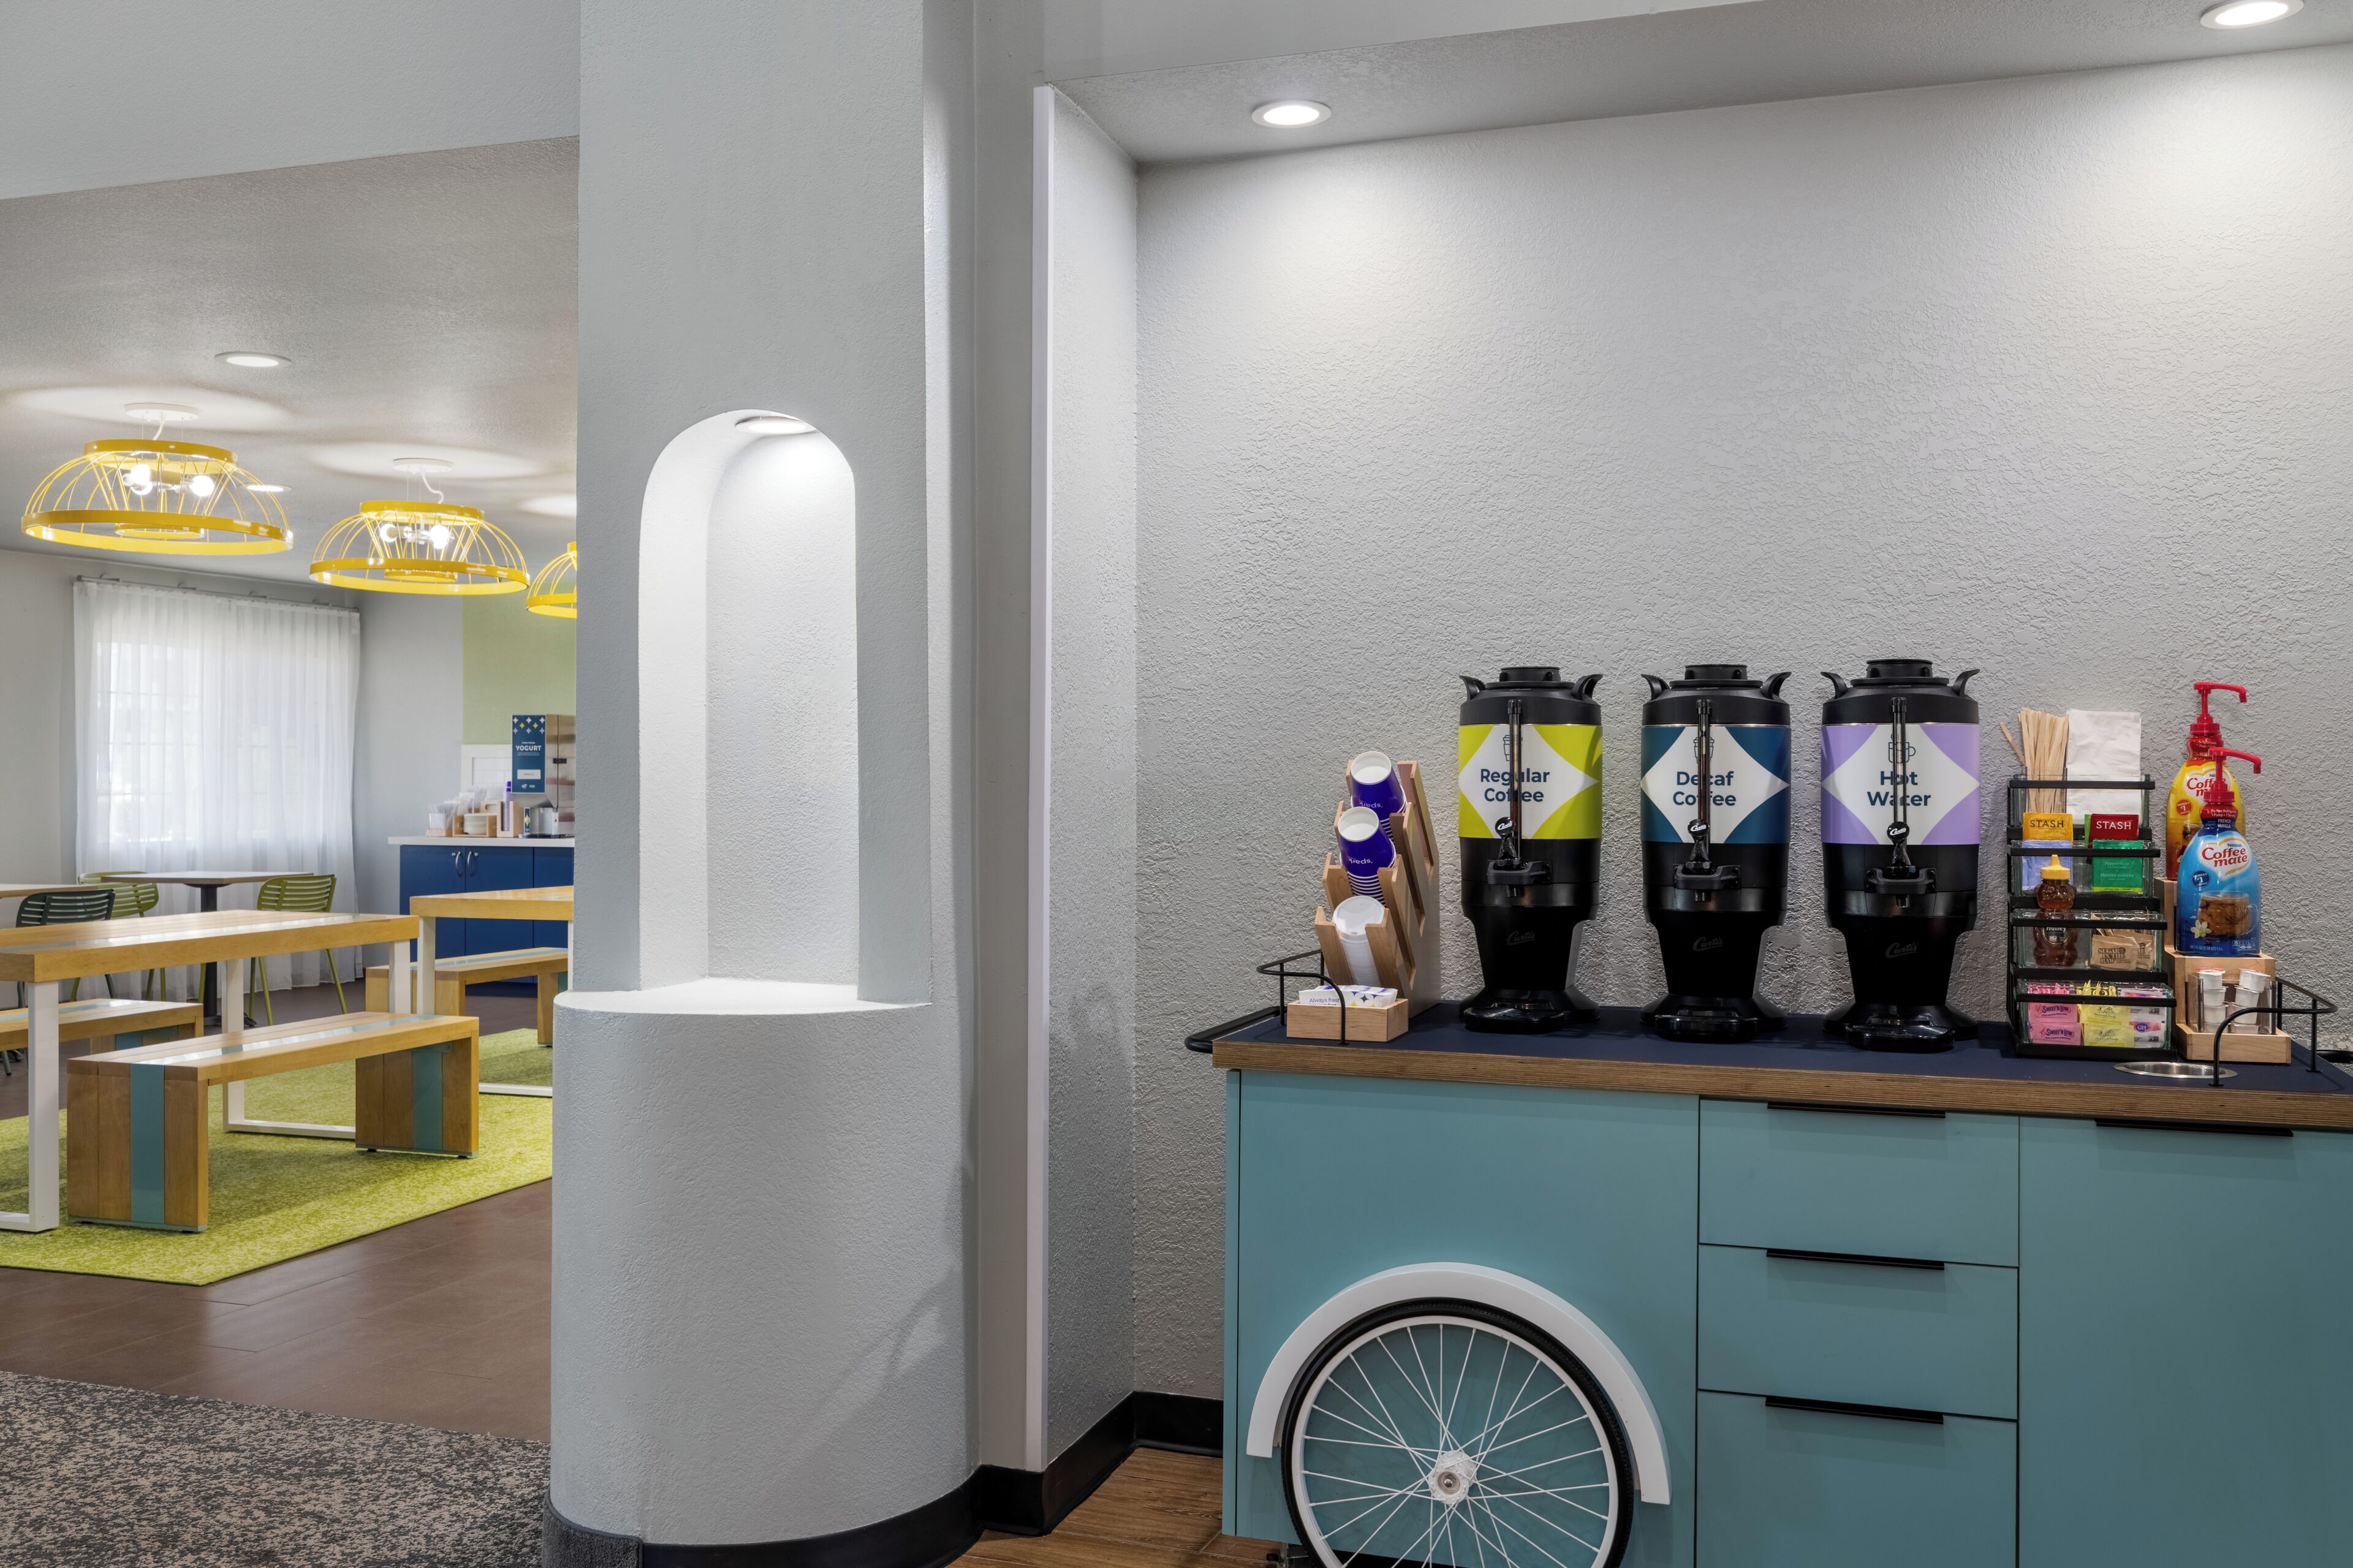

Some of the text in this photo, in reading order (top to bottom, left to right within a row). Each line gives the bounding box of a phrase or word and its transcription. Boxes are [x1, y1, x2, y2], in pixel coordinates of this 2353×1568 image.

[1880, 771, 1919, 786] Hot
[2096, 820, 2132, 830] STASH
[2202, 847, 2246, 861] Coffee
[2214, 854, 2248, 867] mate
[1507, 931, 1535, 945] Curtis
[1692, 936, 1723, 951] Curtis
[1885, 942, 1917, 958] Curtis
